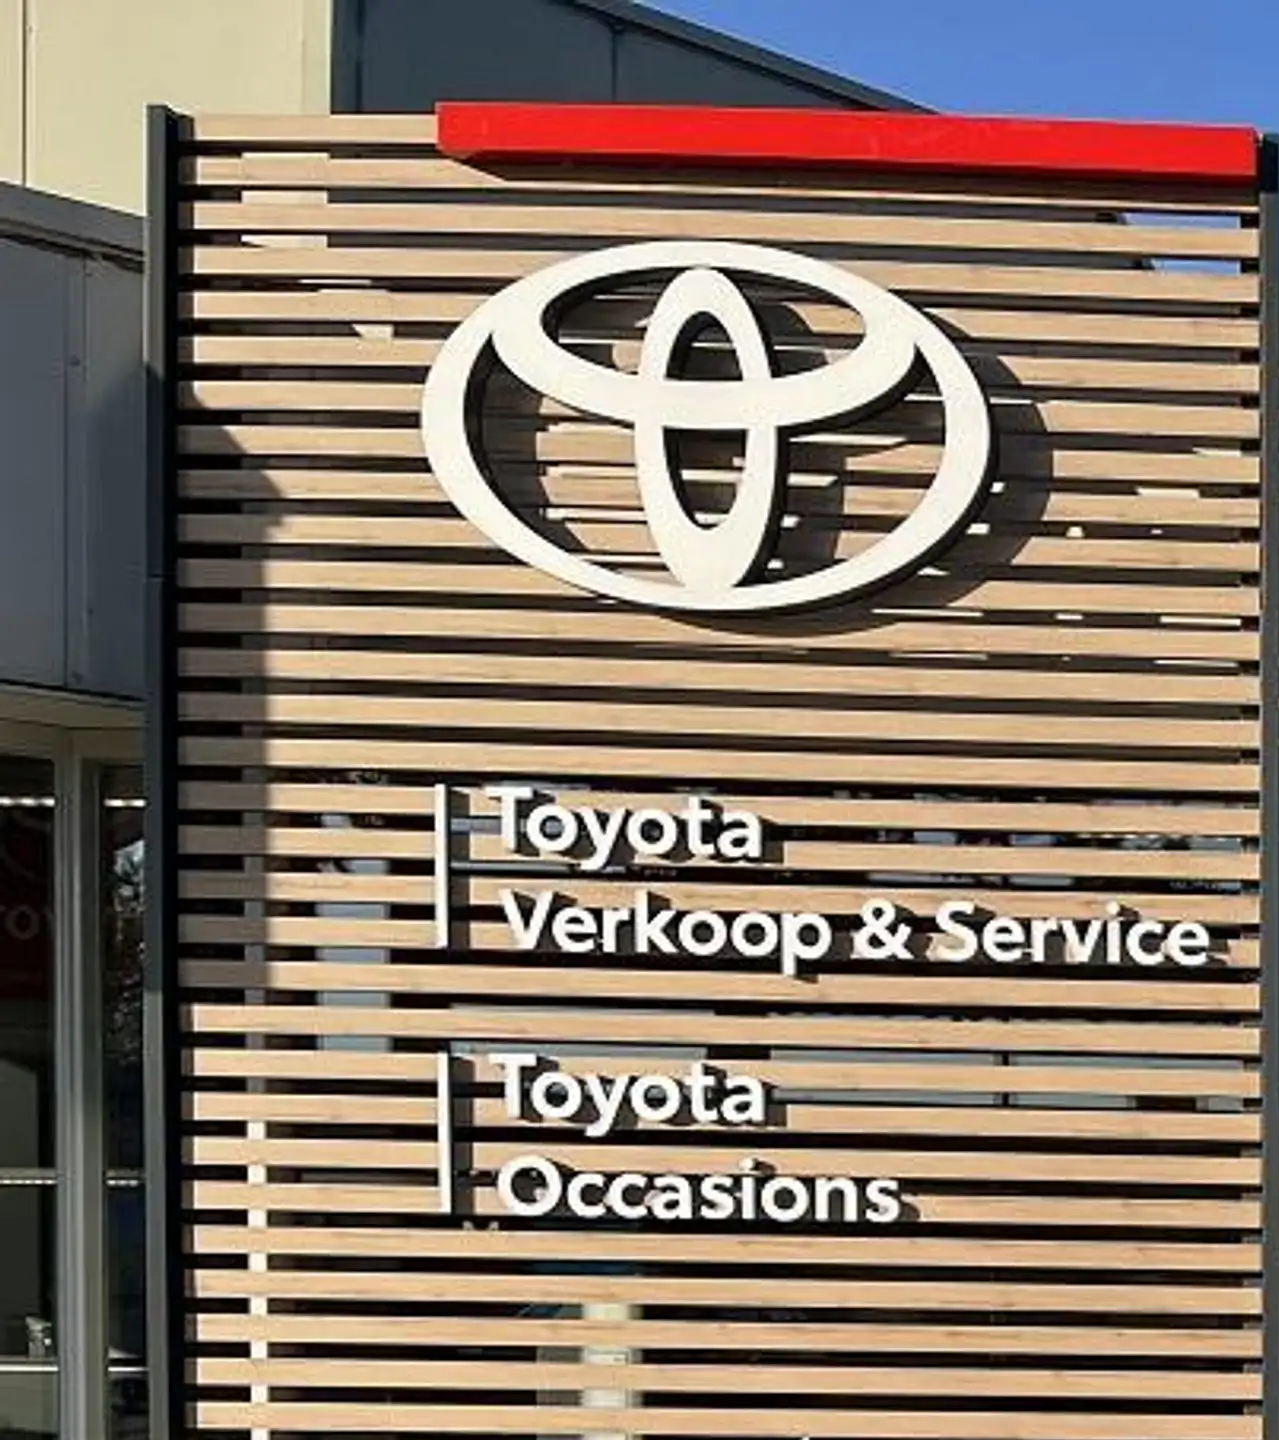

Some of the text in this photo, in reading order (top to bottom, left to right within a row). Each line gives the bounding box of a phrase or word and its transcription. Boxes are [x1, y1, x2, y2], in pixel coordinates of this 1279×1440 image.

[484, 786, 762, 871] Toyota
[500, 889, 1210, 976] Verkoop & Service
[489, 1053, 765, 1138] Toyota
[497, 1155, 900, 1223] Occasions
